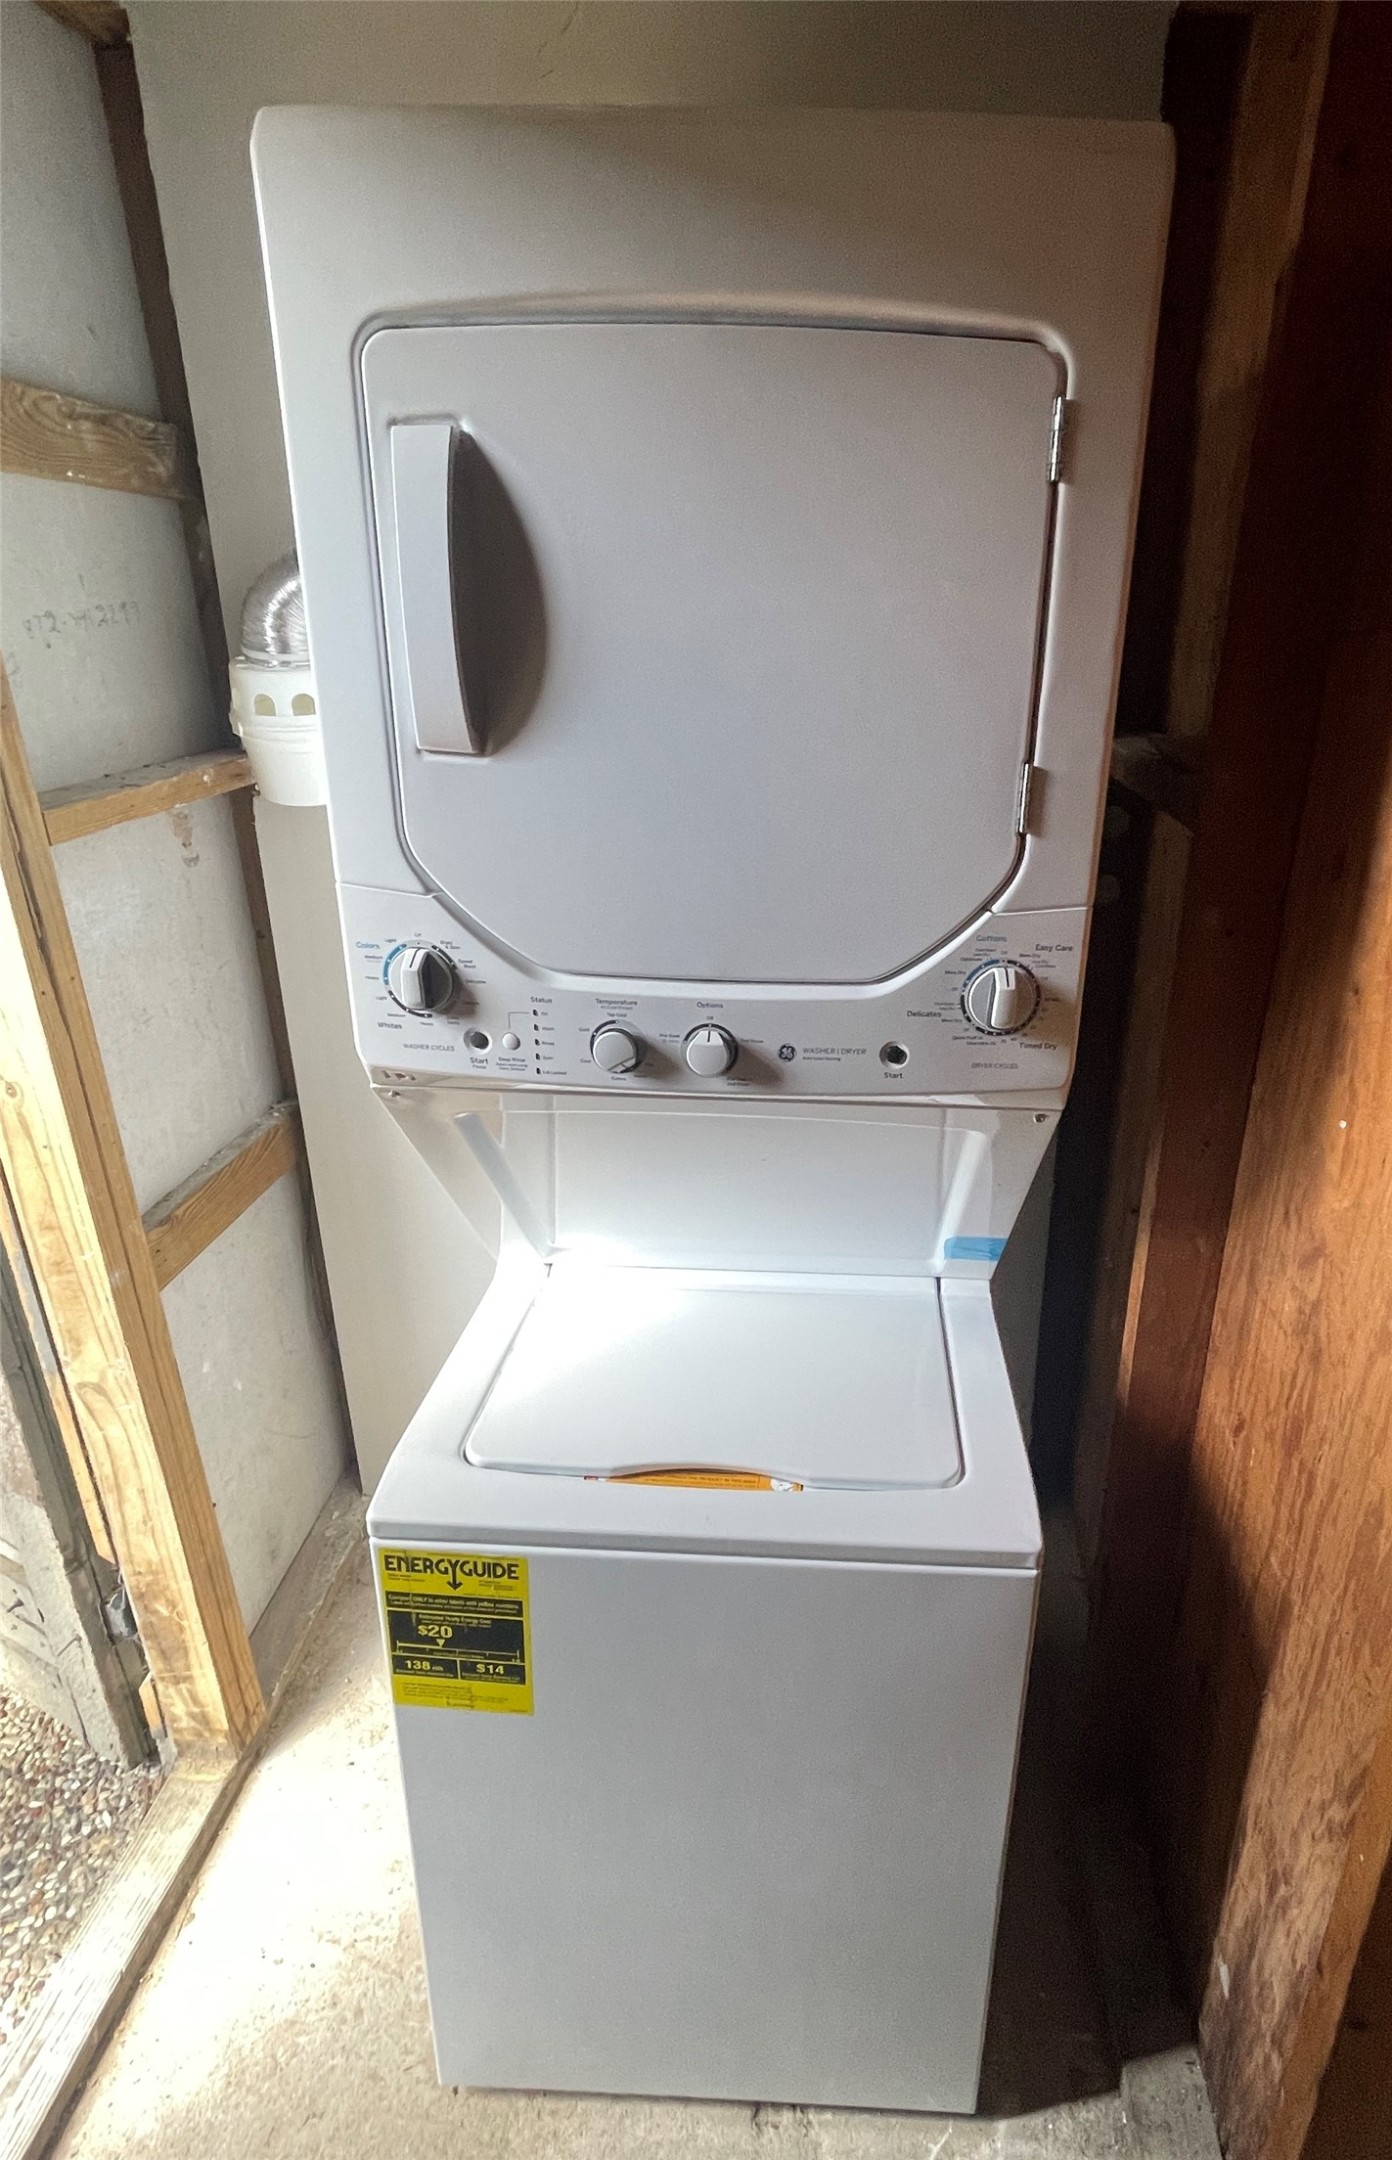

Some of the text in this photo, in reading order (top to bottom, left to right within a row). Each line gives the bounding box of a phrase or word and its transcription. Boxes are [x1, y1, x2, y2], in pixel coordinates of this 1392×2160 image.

[356, 941, 380, 949] Colors
[1035, 944, 1073, 953] Easy Care
[530, 996, 553, 1004] Status
[595, 998, 638, 1007] Temperature
[697, 1001, 724, 1009] Options
[907, 1010, 942, 1018] Delicates
[377, 1022, 403, 1030] Whites
[403, 1043, 429, 1051] WASHER
[1020, 1042, 1057, 1051] Timed Dry
[470, 1057, 489, 1066] Start
[884, 1072, 904, 1080] Start
[384, 1554, 520, 1581] ENERGYGUIDE
[418, 1625, 453, 1639] $20
[404, 1660, 431, 1671] 138
[476, 1663, 505, 1675] $14
